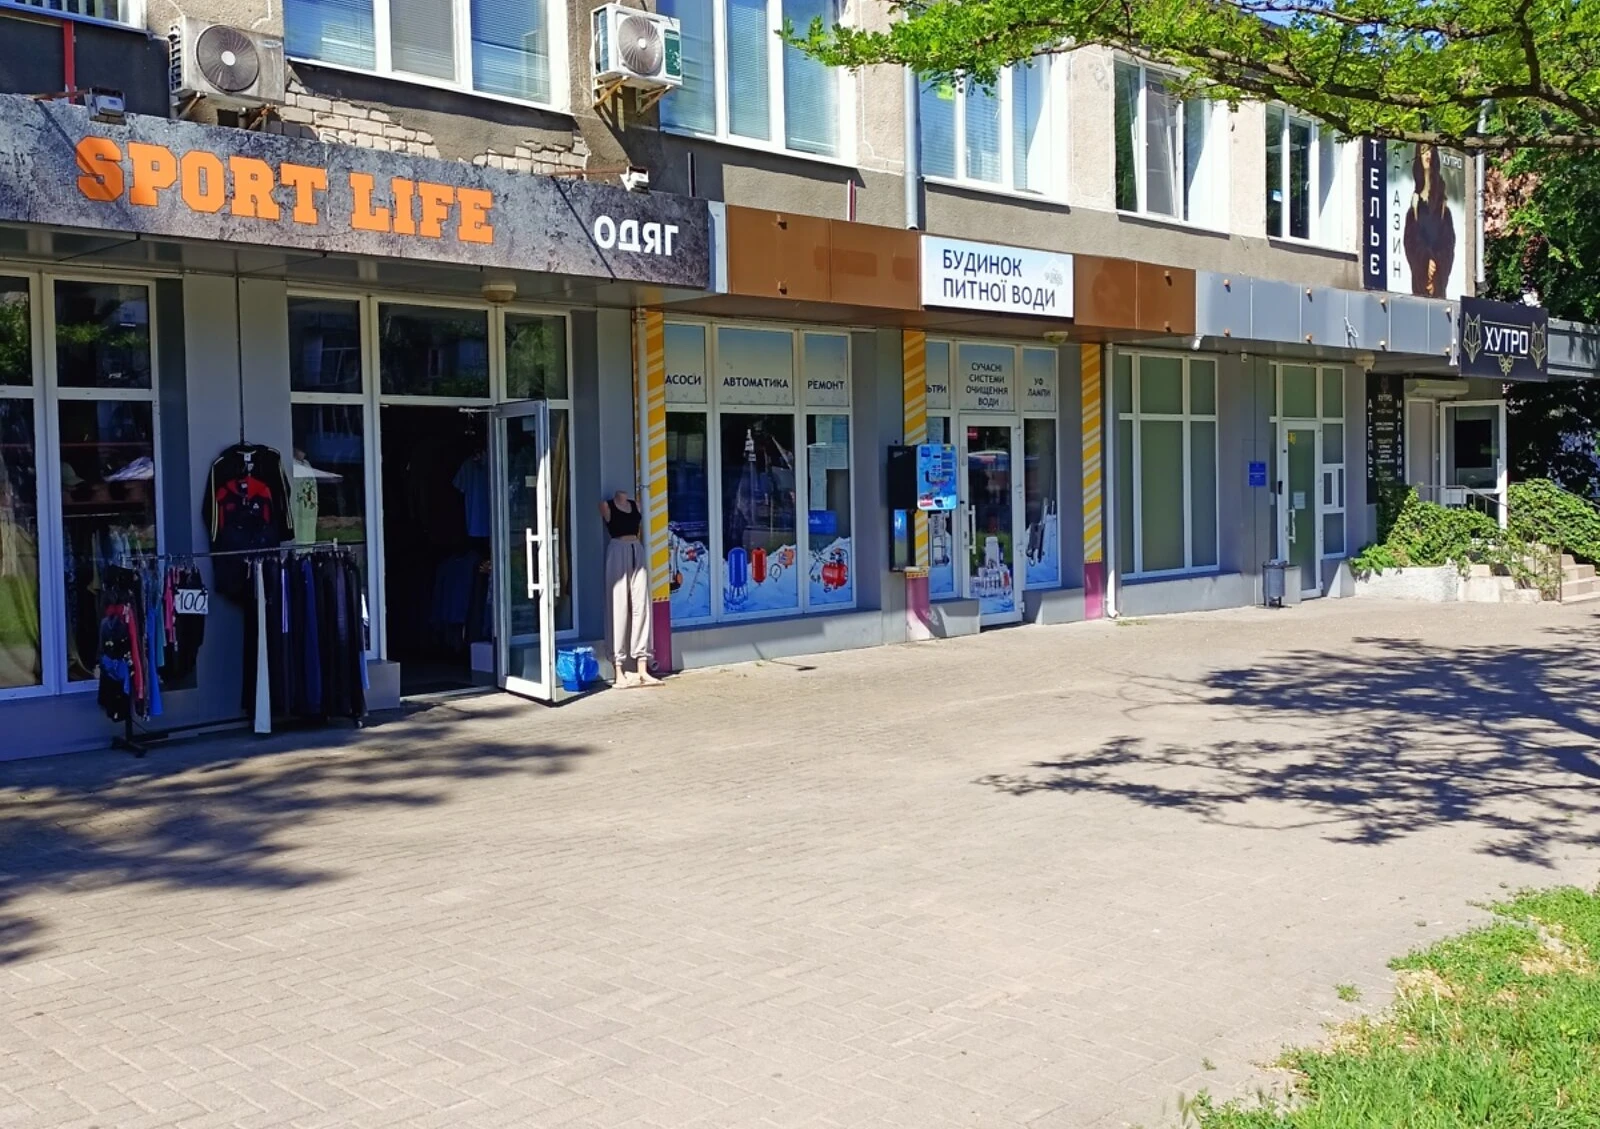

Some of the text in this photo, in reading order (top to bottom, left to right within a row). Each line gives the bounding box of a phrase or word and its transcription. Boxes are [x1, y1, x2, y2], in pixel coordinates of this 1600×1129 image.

[1442, 154, 1462, 169] ХУТРО
[76, 134, 494, 244] SPORT LIFE
[1369, 139, 1381, 275] ТЕЛЬЄ
[1392, 148, 1402, 279] АГАЗИН
[594, 214, 680, 257] ОДЯГ
[942, 249, 1022, 277] БУДИНОК
[943, 277, 1056, 311] ПИТНОЇ ВОДИ
[1484, 325, 1529, 355] ХУТРО
[971, 362, 1003, 373] СУЧАСНІ
[665, 374, 702, 386] АСОСИ
[723, 376, 789, 389] АВТОМАТИКА
[968, 373, 1005, 383] СИСТЕМИ
[1033, 377, 1044, 386] УФ
[807, 380, 845, 390] РЕМОНТ
[926, 384, 947, 394] ЬТРИ
[965, 384, 1008, 396] ОЧИЩЕННЯ
[1027, 388, 1051, 397] ЛАМПИ
[977, 397, 1000, 408] ВОДИ
